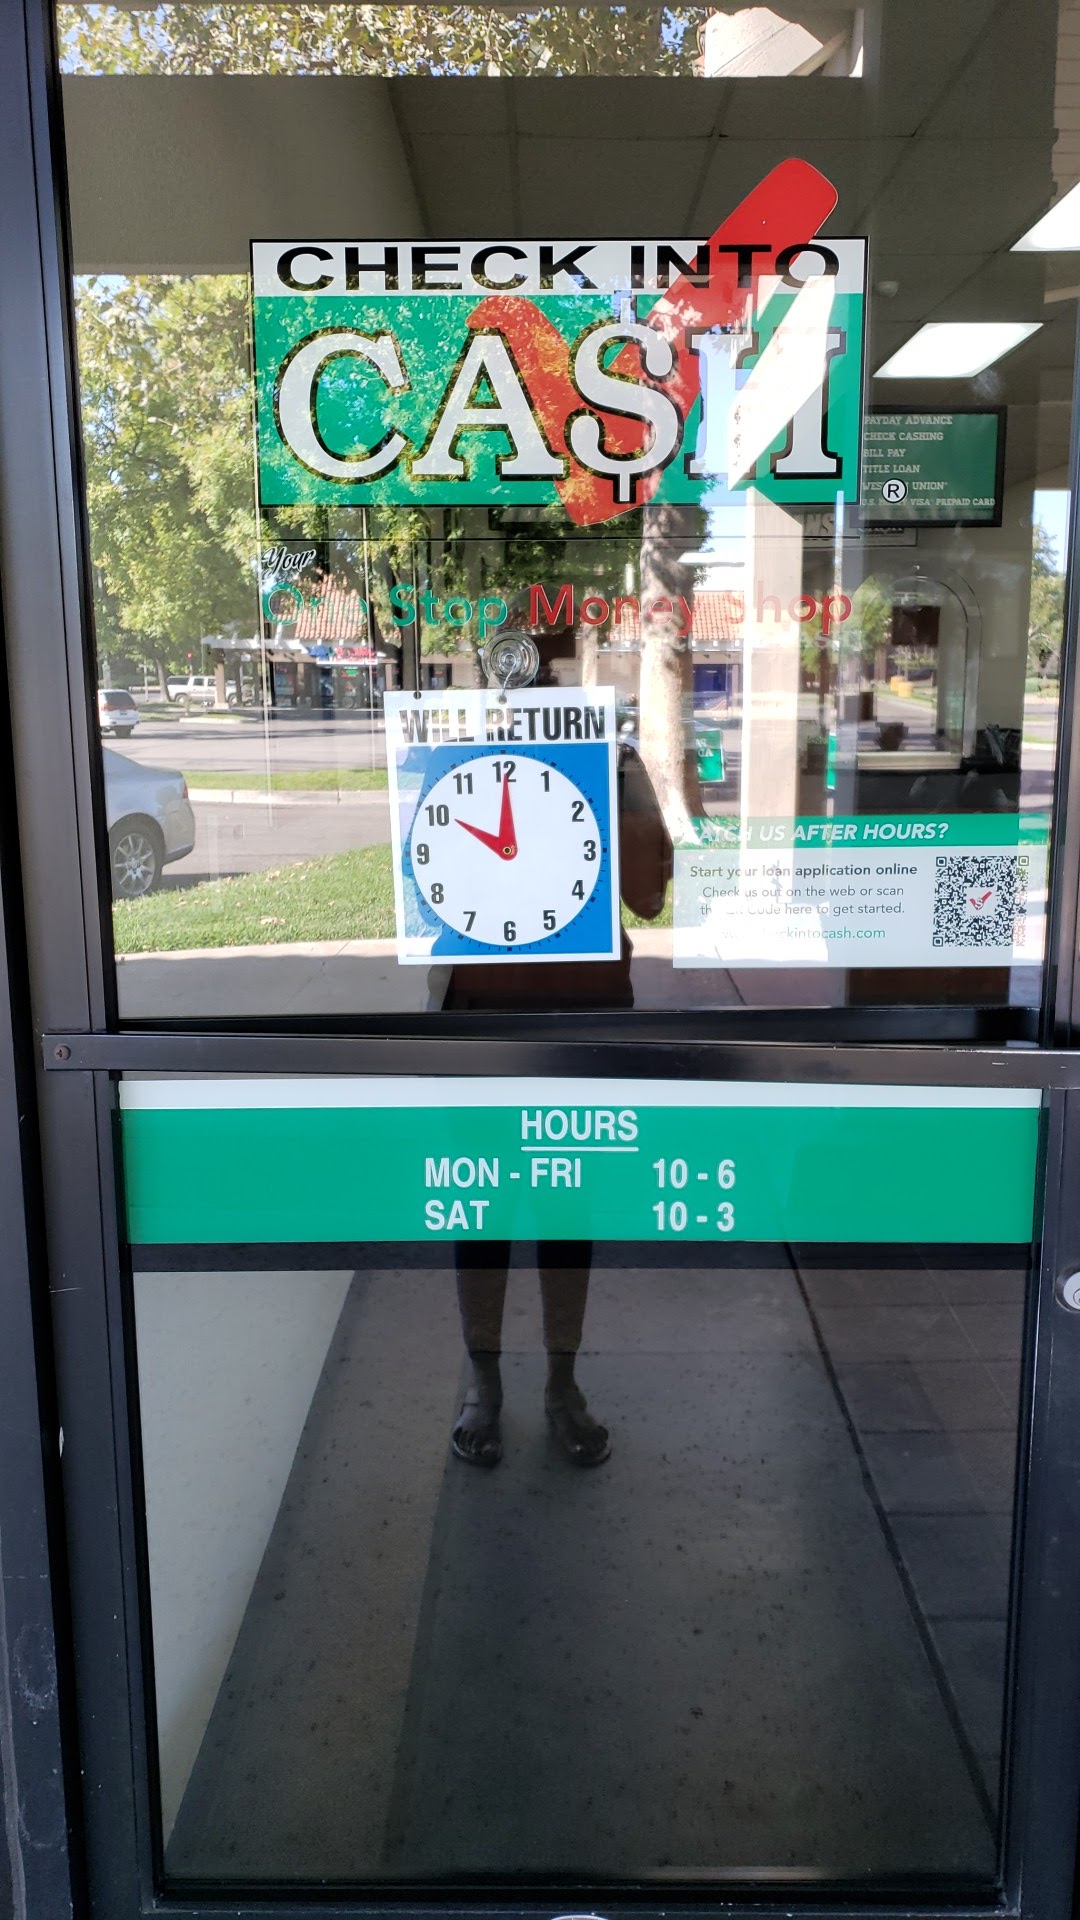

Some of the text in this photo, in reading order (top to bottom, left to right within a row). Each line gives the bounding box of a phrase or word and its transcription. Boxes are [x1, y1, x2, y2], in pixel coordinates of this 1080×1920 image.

[276, 243, 840, 291] CHECK INTO
[864, 416, 953, 425] PAYDAY ADVANCE
[863, 432, 944, 441] CHECK CASHING
[863, 449, 906, 457] BILL PAY
[863, 465, 920, 473] TITLE LOAN
[911, 498, 931, 506] VISA
[936, 498, 970, 506] PREPAID
[973, 498, 995, 506] CARD
[261, 547, 317, 581] Your
[388, 583, 508, 639] Stop
[529, 583, 695, 637] Money
[726, 581, 852, 636] Shop
[399, 706, 606, 743] WILL RETURN
[492, 761, 517, 783] 12
[541, 771, 550, 792] 1
[453, 773, 474, 795] 11
[425, 804, 449, 826] 10
[571, 801, 585, 822] 2
[759, 825, 786, 841] US
[791, 824, 858, 841] AFTER
[863, 823, 949, 841] HOURS?
[416, 843, 430, 865] 9
[583, 840, 597, 861] 3
[690, 865, 723, 877] Start
[762, 865, 791, 877] loan
[795, 864, 873, 879] application
[876, 864, 917, 876] online
[431, 883, 444, 904] 8
[572, 880, 585, 900] 4
[702, 885, 904, 898] Check us out on the web or scan
[785, 903, 812, 914] here
[816, 904, 829, 914] to
[833, 904, 854, 917] get
[857, 902, 905, 914] started.
[463, 911, 477, 932] 7
[543, 910, 556, 931] 5
[504, 921, 517, 942] 6
[521, 1110, 639, 1140] HOURS
[425, 1157, 499, 1187] MON
[531, 1158, 581, 1187] FRI
[653, 1158, 688, 1188] 10
[717, 1159, 736, 1189] 6
[425, 1200, 489, 1230] SAT
[652, 1201, 688, 1231] 10
[717, 1202, 735, 1231] 3
